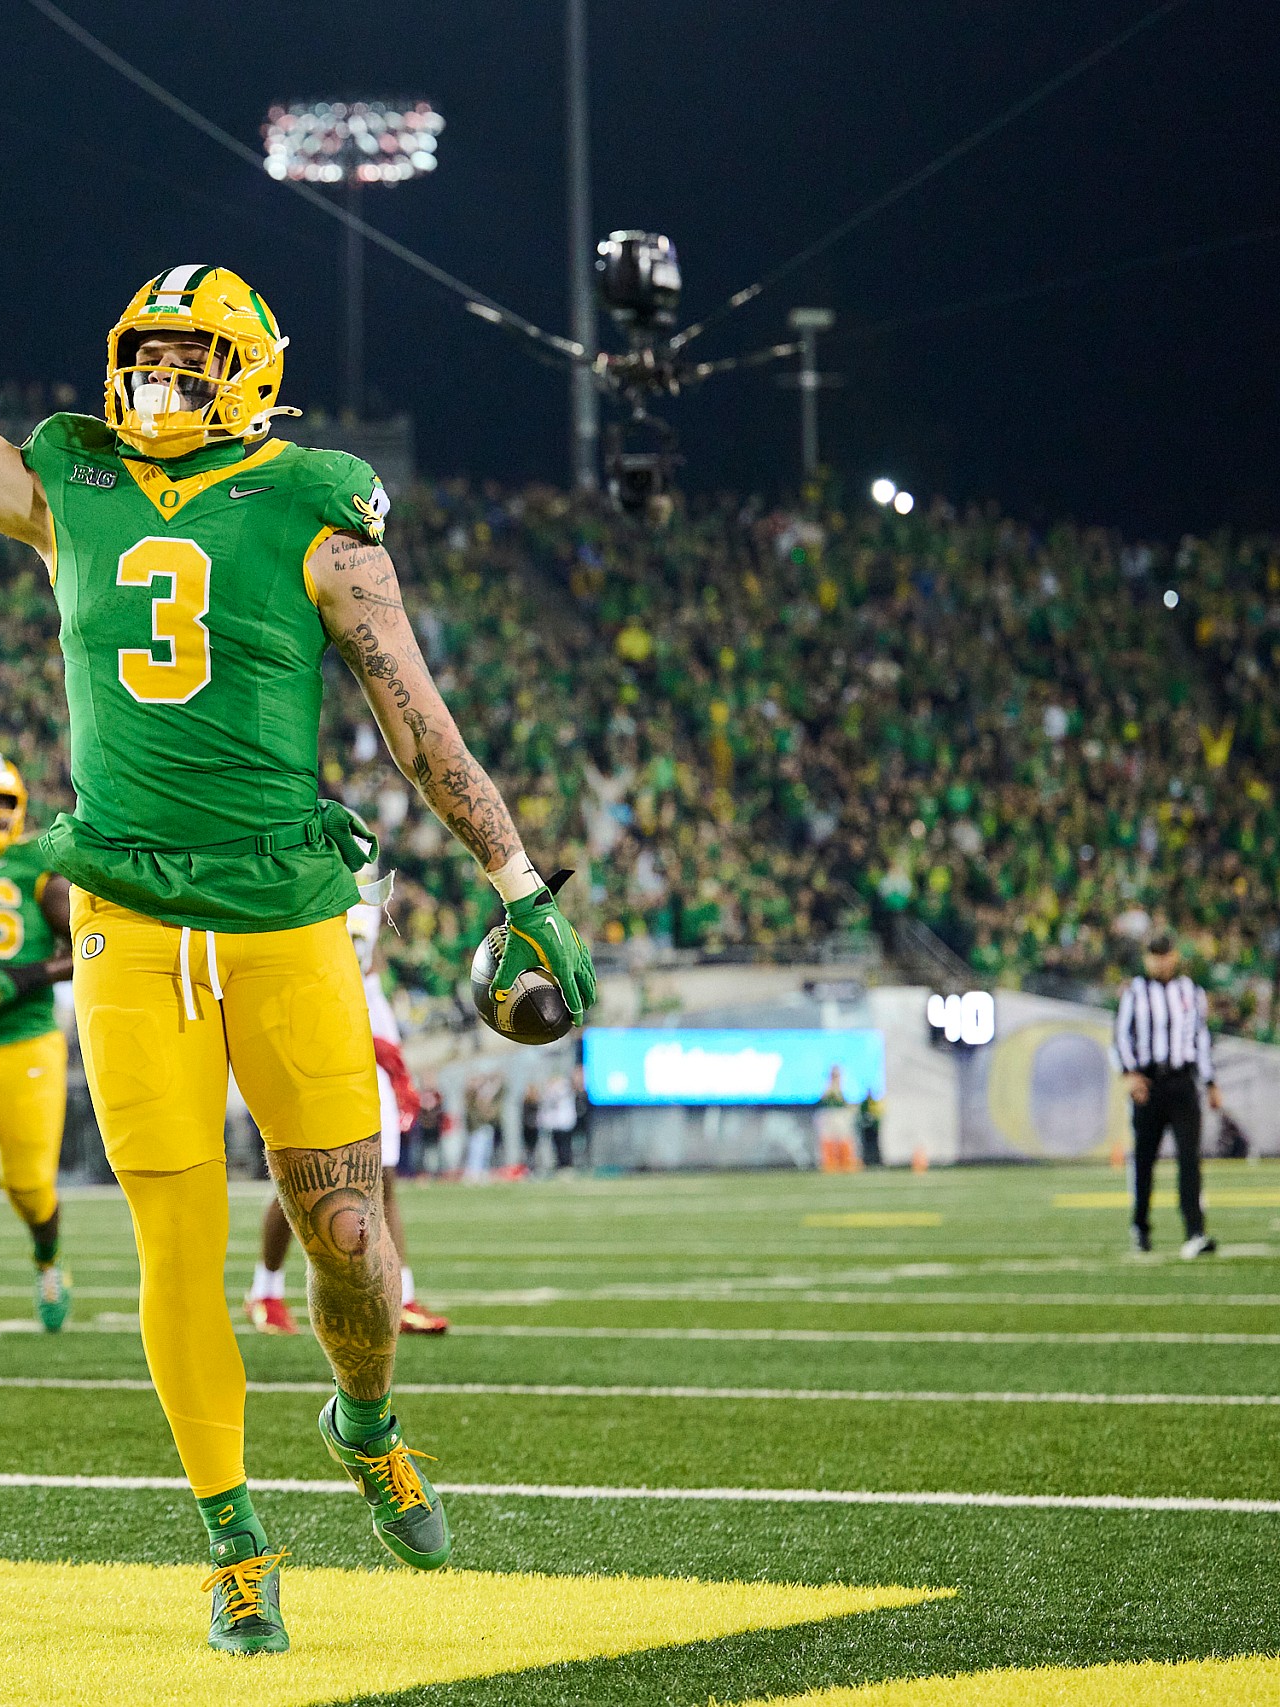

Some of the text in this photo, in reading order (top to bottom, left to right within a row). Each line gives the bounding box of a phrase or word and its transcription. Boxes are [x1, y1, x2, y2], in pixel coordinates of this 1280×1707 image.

[159, 489, 181, 509] O
[334, 560, 346, 572] the
[116, 535, 212, 705] 3
[80, 932, 106, 961] O
[927, 990, 995, 1045] 40
